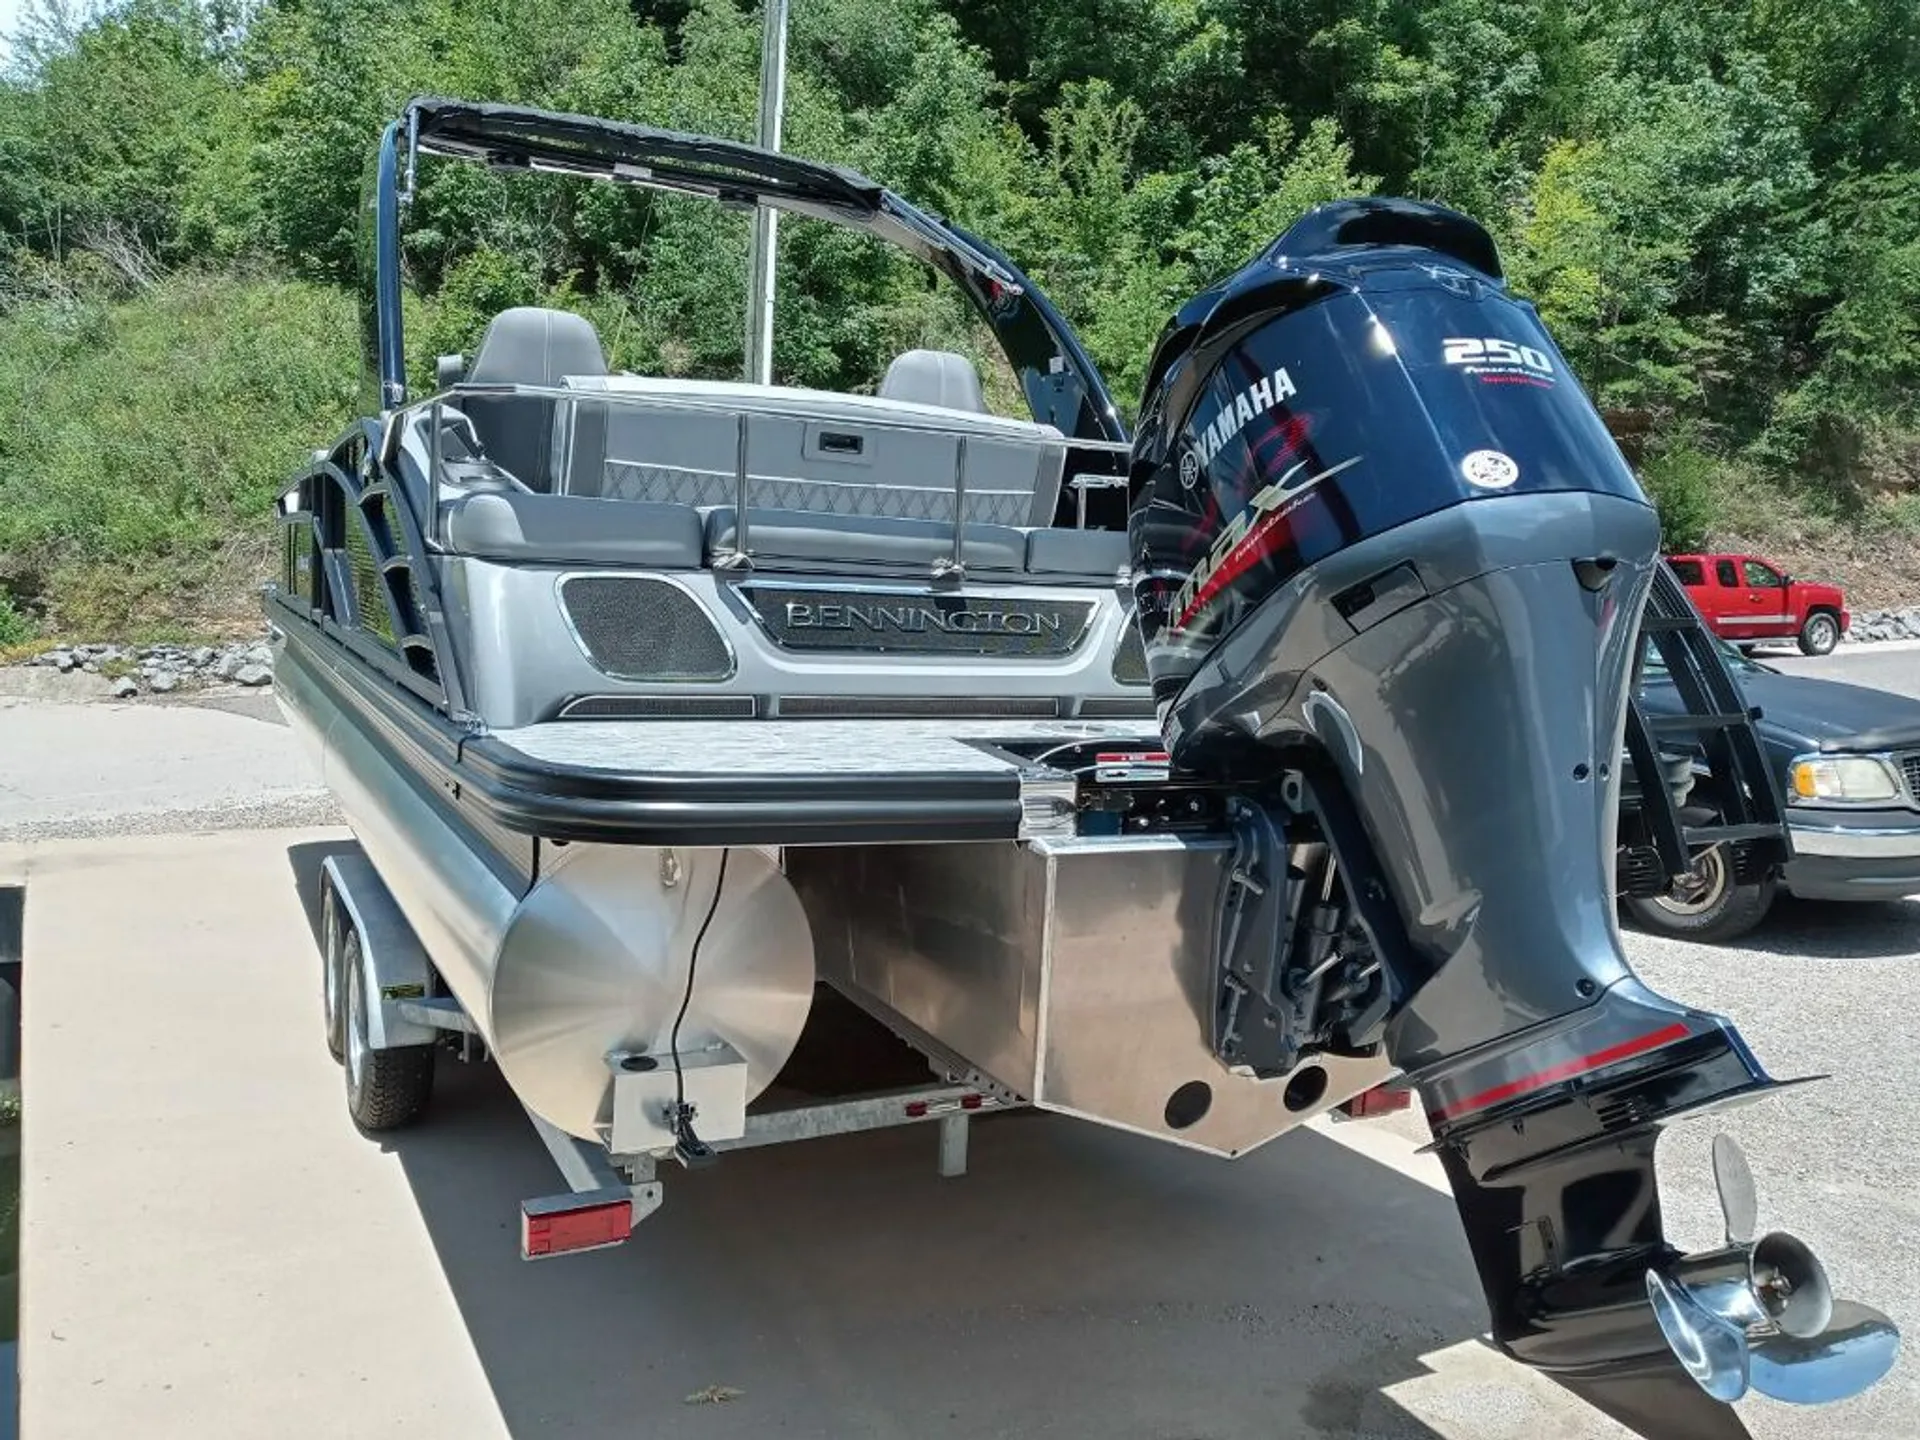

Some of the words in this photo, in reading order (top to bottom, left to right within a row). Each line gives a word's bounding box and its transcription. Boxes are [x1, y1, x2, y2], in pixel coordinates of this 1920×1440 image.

[1442, 338, 1553, 373] 250
[1193, 367, 1297, 470] YAMAHA
[786, 602, 1059, 634] BENNINGTON
